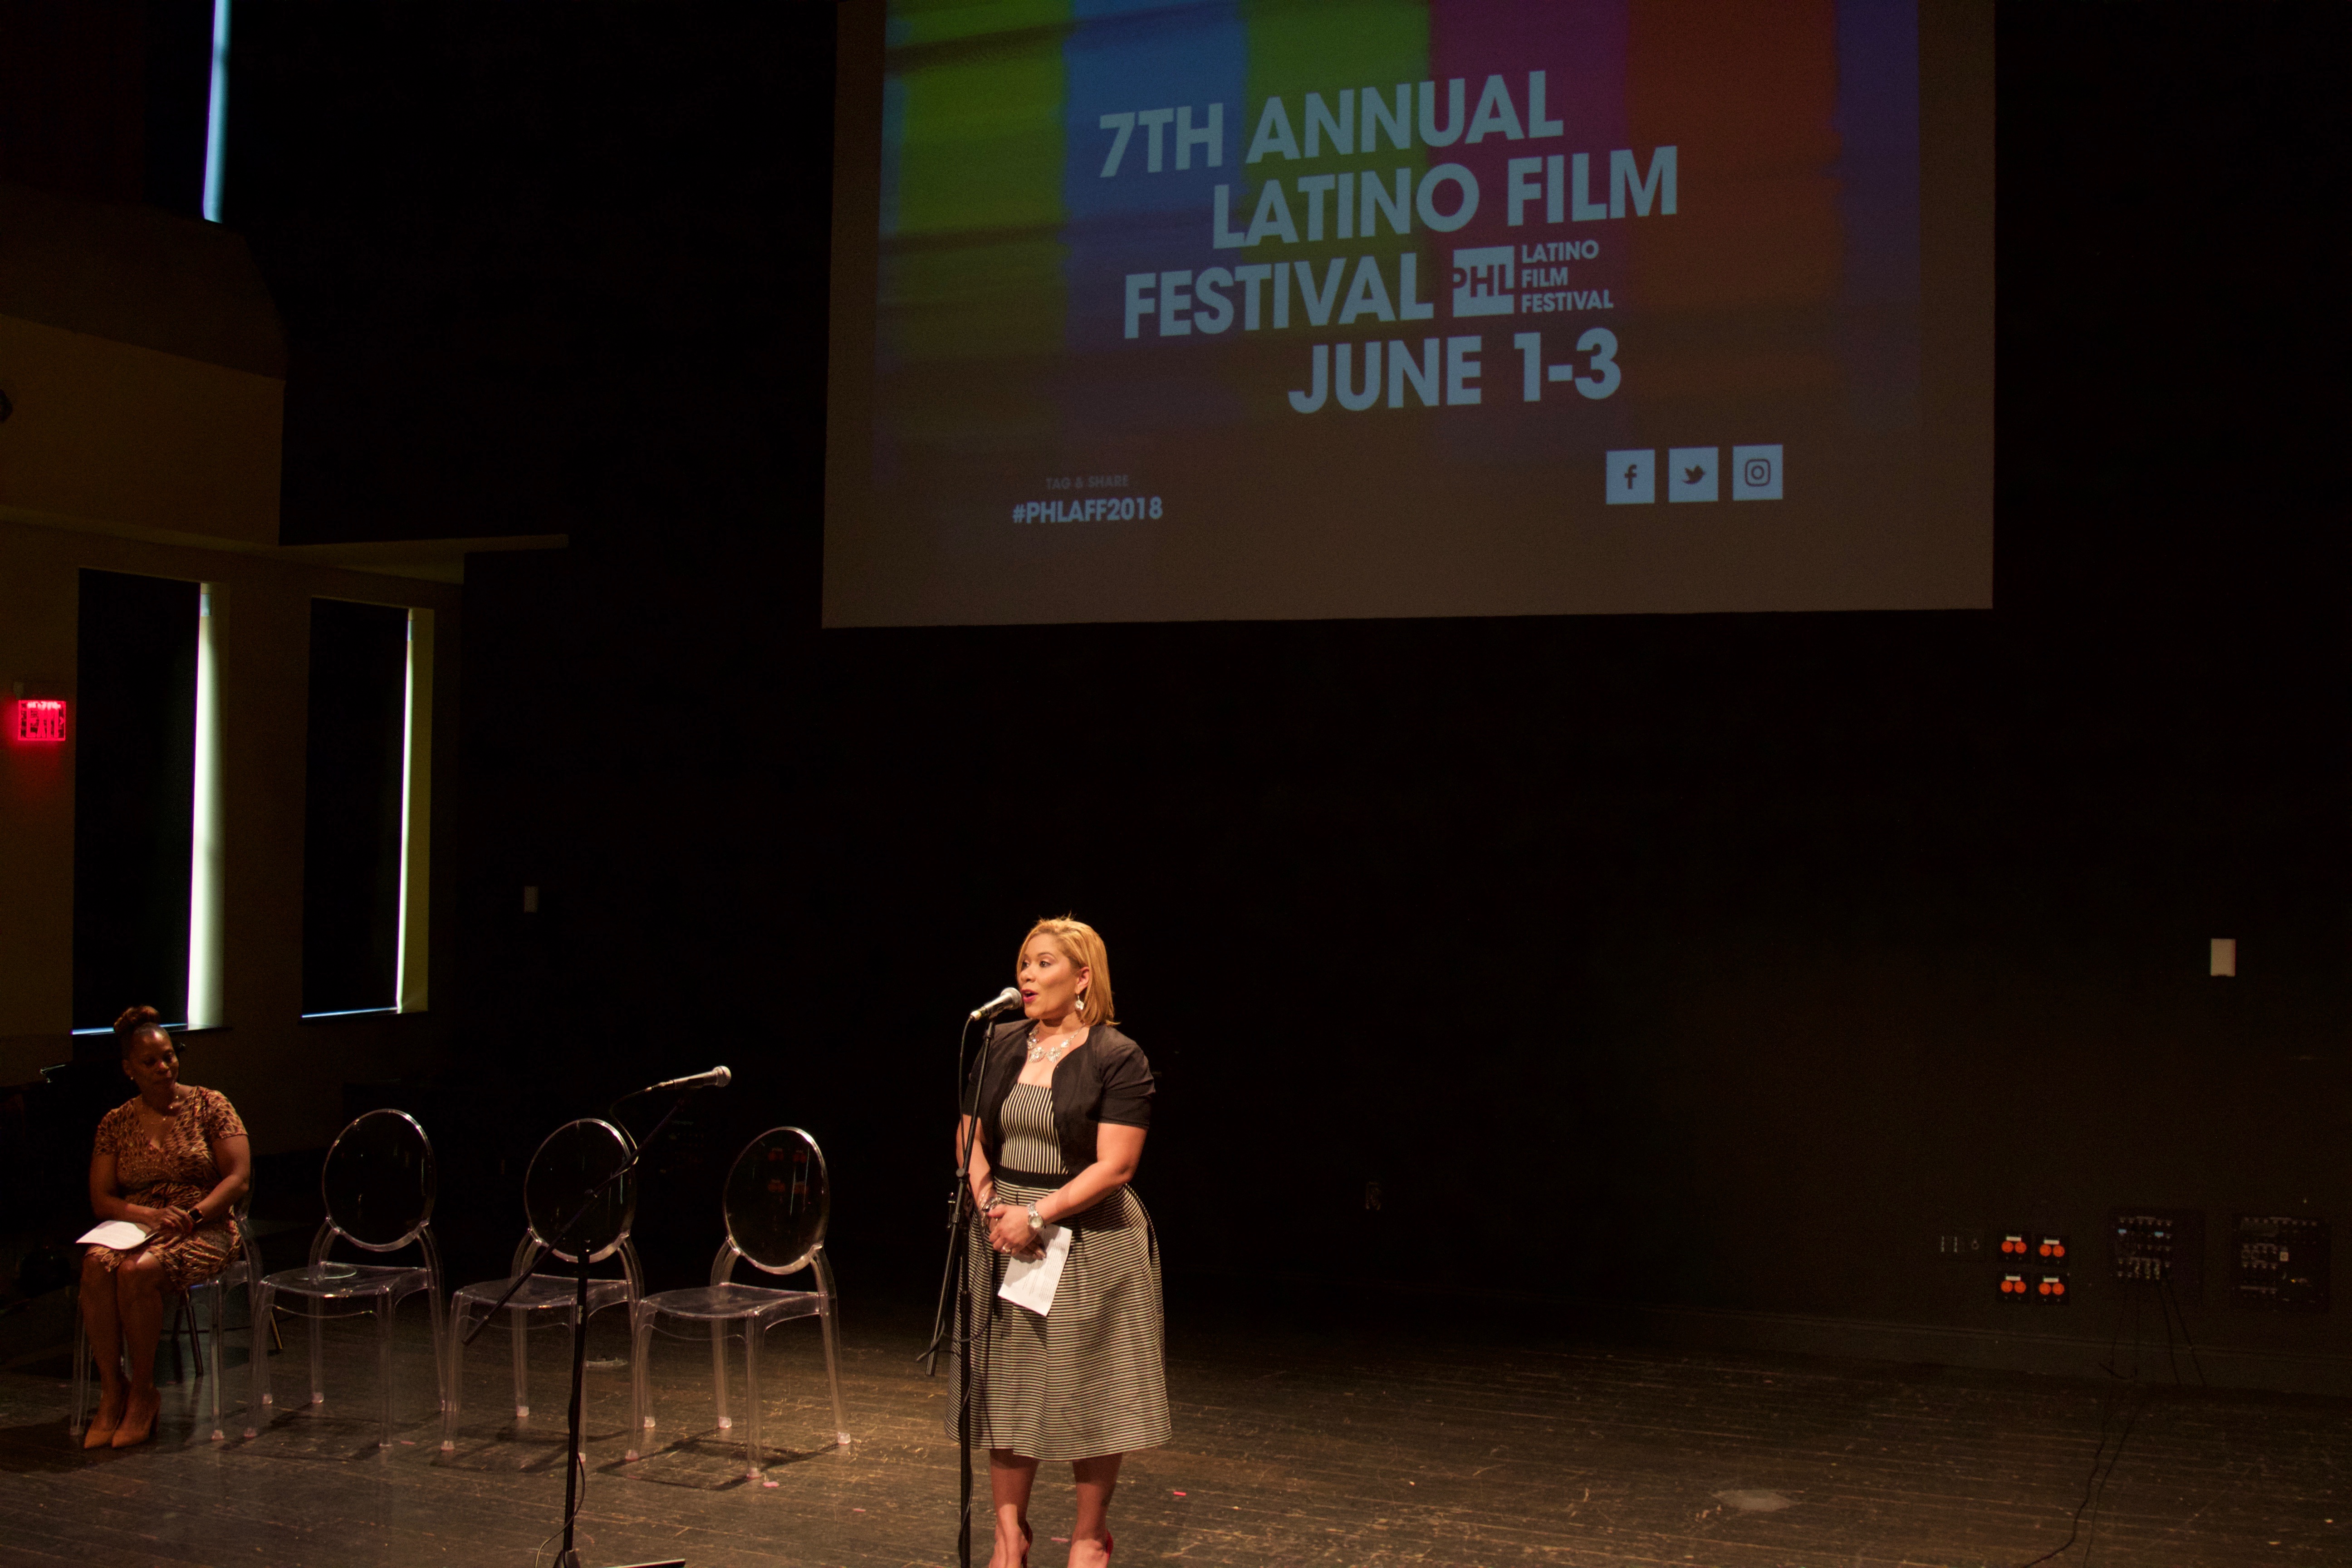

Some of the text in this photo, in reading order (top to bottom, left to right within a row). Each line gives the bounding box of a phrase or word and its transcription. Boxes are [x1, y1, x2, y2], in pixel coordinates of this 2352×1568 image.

[1100, 70, 1564, 178] 7TH ANNUAL
[1213, 146, 1678, 250] LATINO FILM
[1521, 240, 1599, 264] LATINO
[1521, 266, 1568, 289] FILM
[1124, 253, 1434, 340] FESTIVAL
[1521, 289, 1614, 314] FESTIVAL
[1289, 328, 1622, 414] JUNE 1-3
[1046, 477, 1071, 490] TAG
[1088, 475, 1129, 488] SHARE
[1012, 496, 1163, 524] #PHLAFF2018
